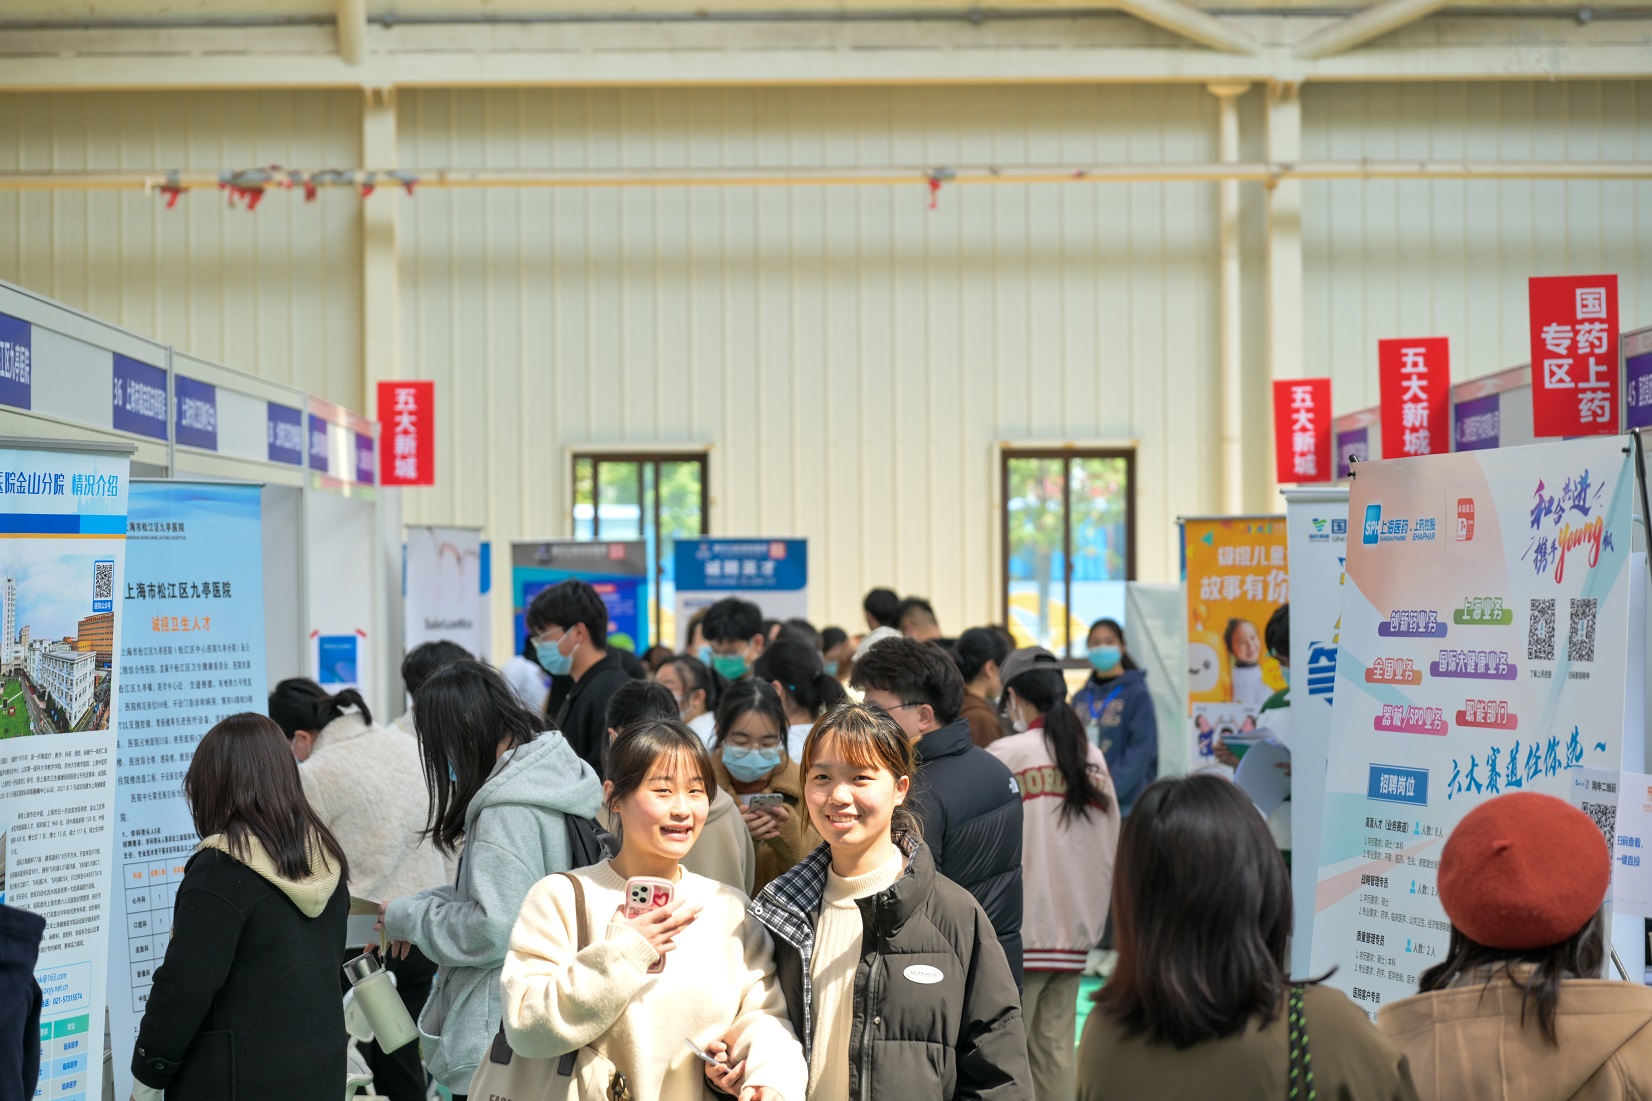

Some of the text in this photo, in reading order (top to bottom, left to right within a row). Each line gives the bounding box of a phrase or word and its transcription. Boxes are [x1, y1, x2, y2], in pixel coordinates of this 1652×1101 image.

[1541, 322, 1575, 389] 专区
[1575, 287, 1611, 423] 国药上药
[113, 377, 122, 406] 36
[1401, 347, 1430, 455] 五大新城
[394, 388, 417, 479] 五大新城
[1291, 385, 1317, 477] 五大新城
[72, 473, 118, 497] 情况介绍
[1380, 519, 1408, 534] 上海医药
[1414, 518, 1436, 532] 上药控股
[1412, 532, 1436, 540] SHAPHAR
[125, 581, 232, 600] 上海市松江区九亭医院
[1201, 568, 1289, 603] 故事有你
[1462, 597, 1504, 620] 上海业务
[151, 615, 211, 632] 诚招卫生人才
[1390, 610, 1438, 633] 创新药业务
[1373, 658, 1414, 681] 全国业务
[1438, 650, 1508, 675] 国际大健康业务
[1382, 704, 1443, 730] 器械/SPD业务
[1465, 699, 1508, 725] 职能部门
[1379, 773, 1416, 797] 招聘岗位
[52, 993, 82, 1004] 021-57315574
[64, 1040, 78, 1050] 临床医学
[62, 1060, 78, 1070] 临床医学
[62, 1080, 77, 1090] 临床医学
